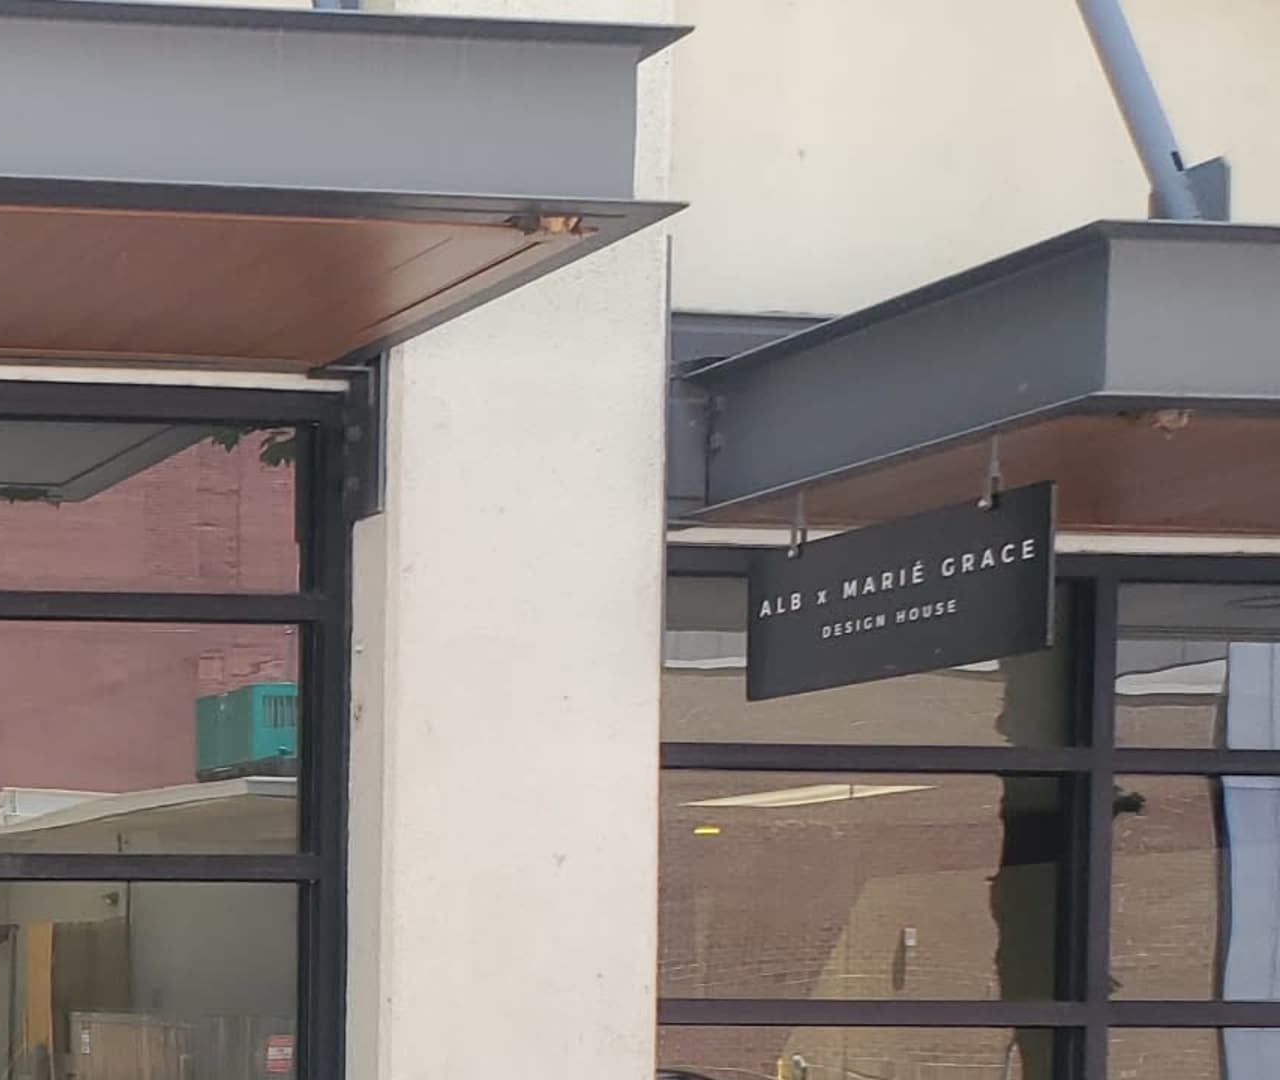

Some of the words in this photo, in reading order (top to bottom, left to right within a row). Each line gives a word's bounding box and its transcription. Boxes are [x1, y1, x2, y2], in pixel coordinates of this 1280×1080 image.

[759, 591, 802, 618] ALB
[842, 560, 925, 600] MARIÉ
[941, 538, 1036, 577] GRACE
[821, 614, 886, 639] DESIGN
[895, 599, 957, 624] HOUSE
